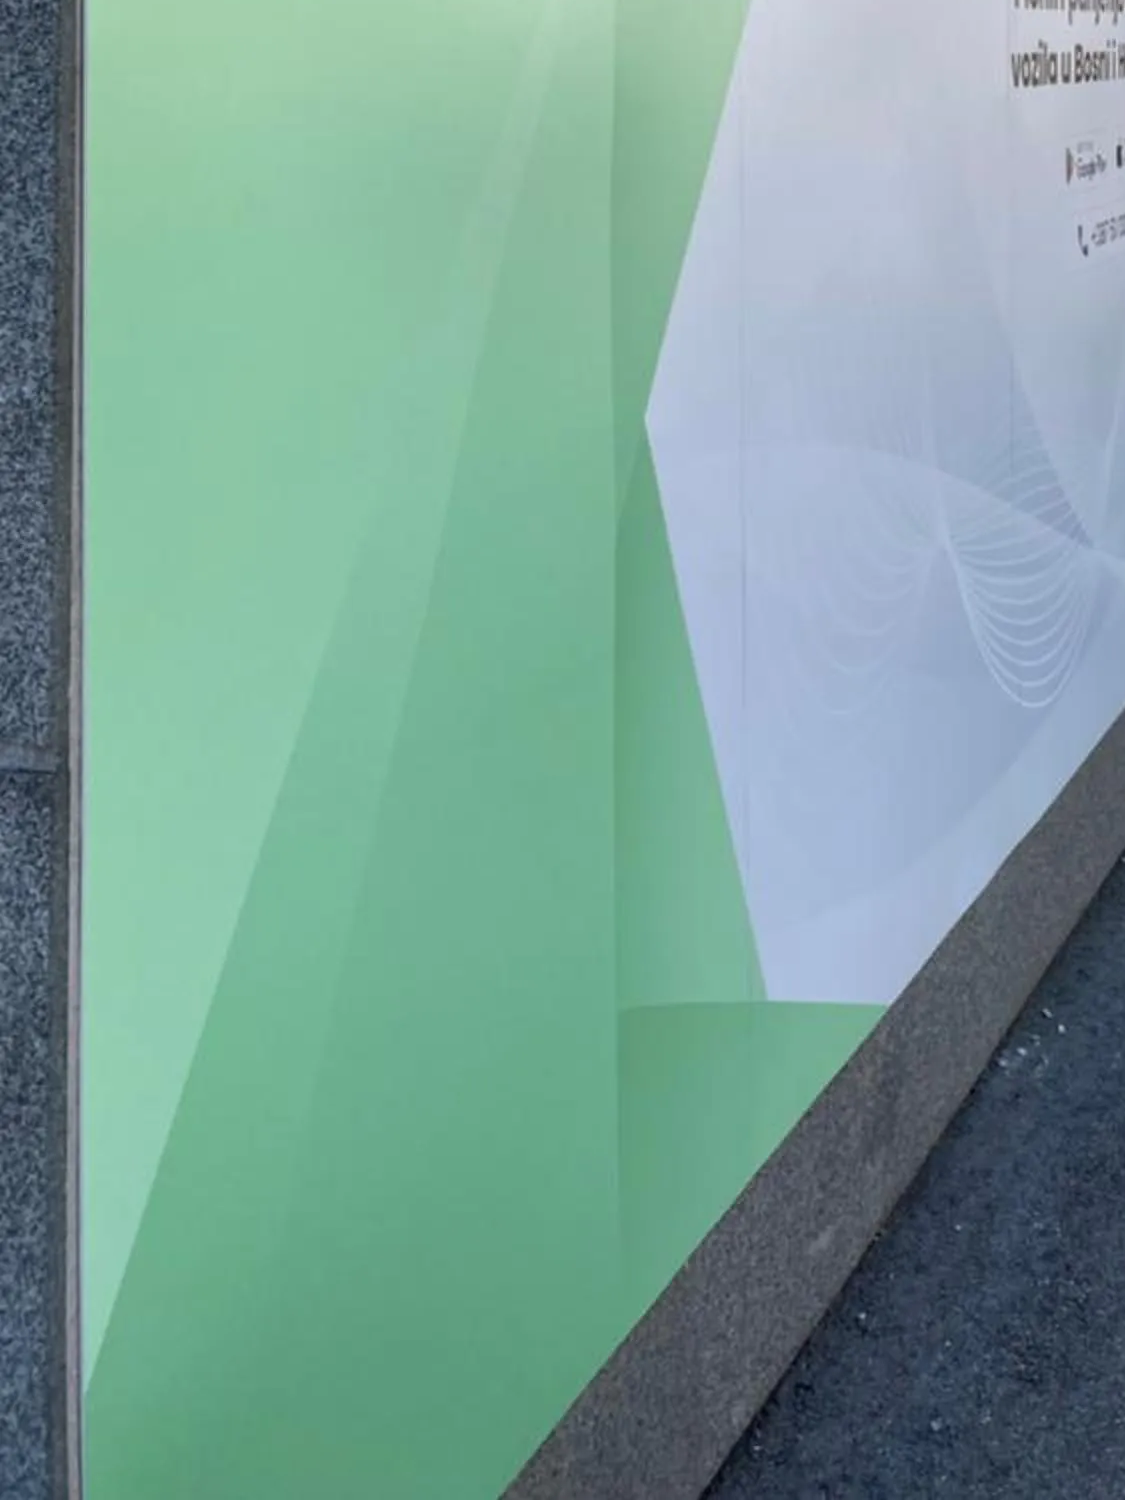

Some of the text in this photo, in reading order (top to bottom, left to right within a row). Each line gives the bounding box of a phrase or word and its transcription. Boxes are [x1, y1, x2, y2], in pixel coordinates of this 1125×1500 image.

[1011, 39, 1058, 88] vozila
[1060, 51, 1072, 84] u
[1074, 38, 1110, 84] Bosni
